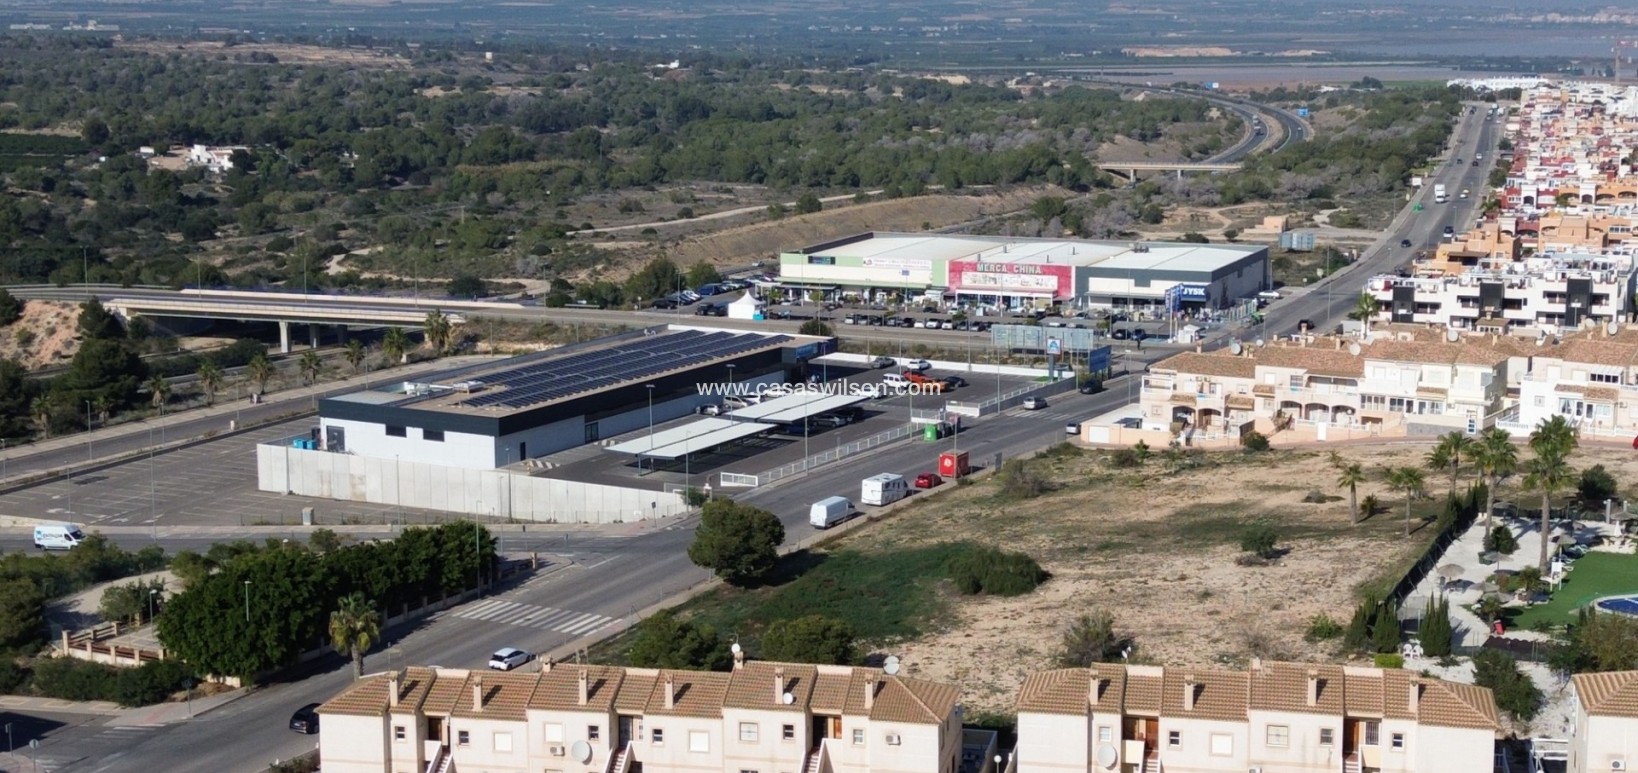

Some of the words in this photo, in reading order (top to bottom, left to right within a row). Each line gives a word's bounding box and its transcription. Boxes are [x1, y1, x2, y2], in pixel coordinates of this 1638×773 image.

[976, 263, 1007, 273] MERCA
[1013, 264, 1042, 274] CHINA
[1183, 287, 1205, 296] JYSK
